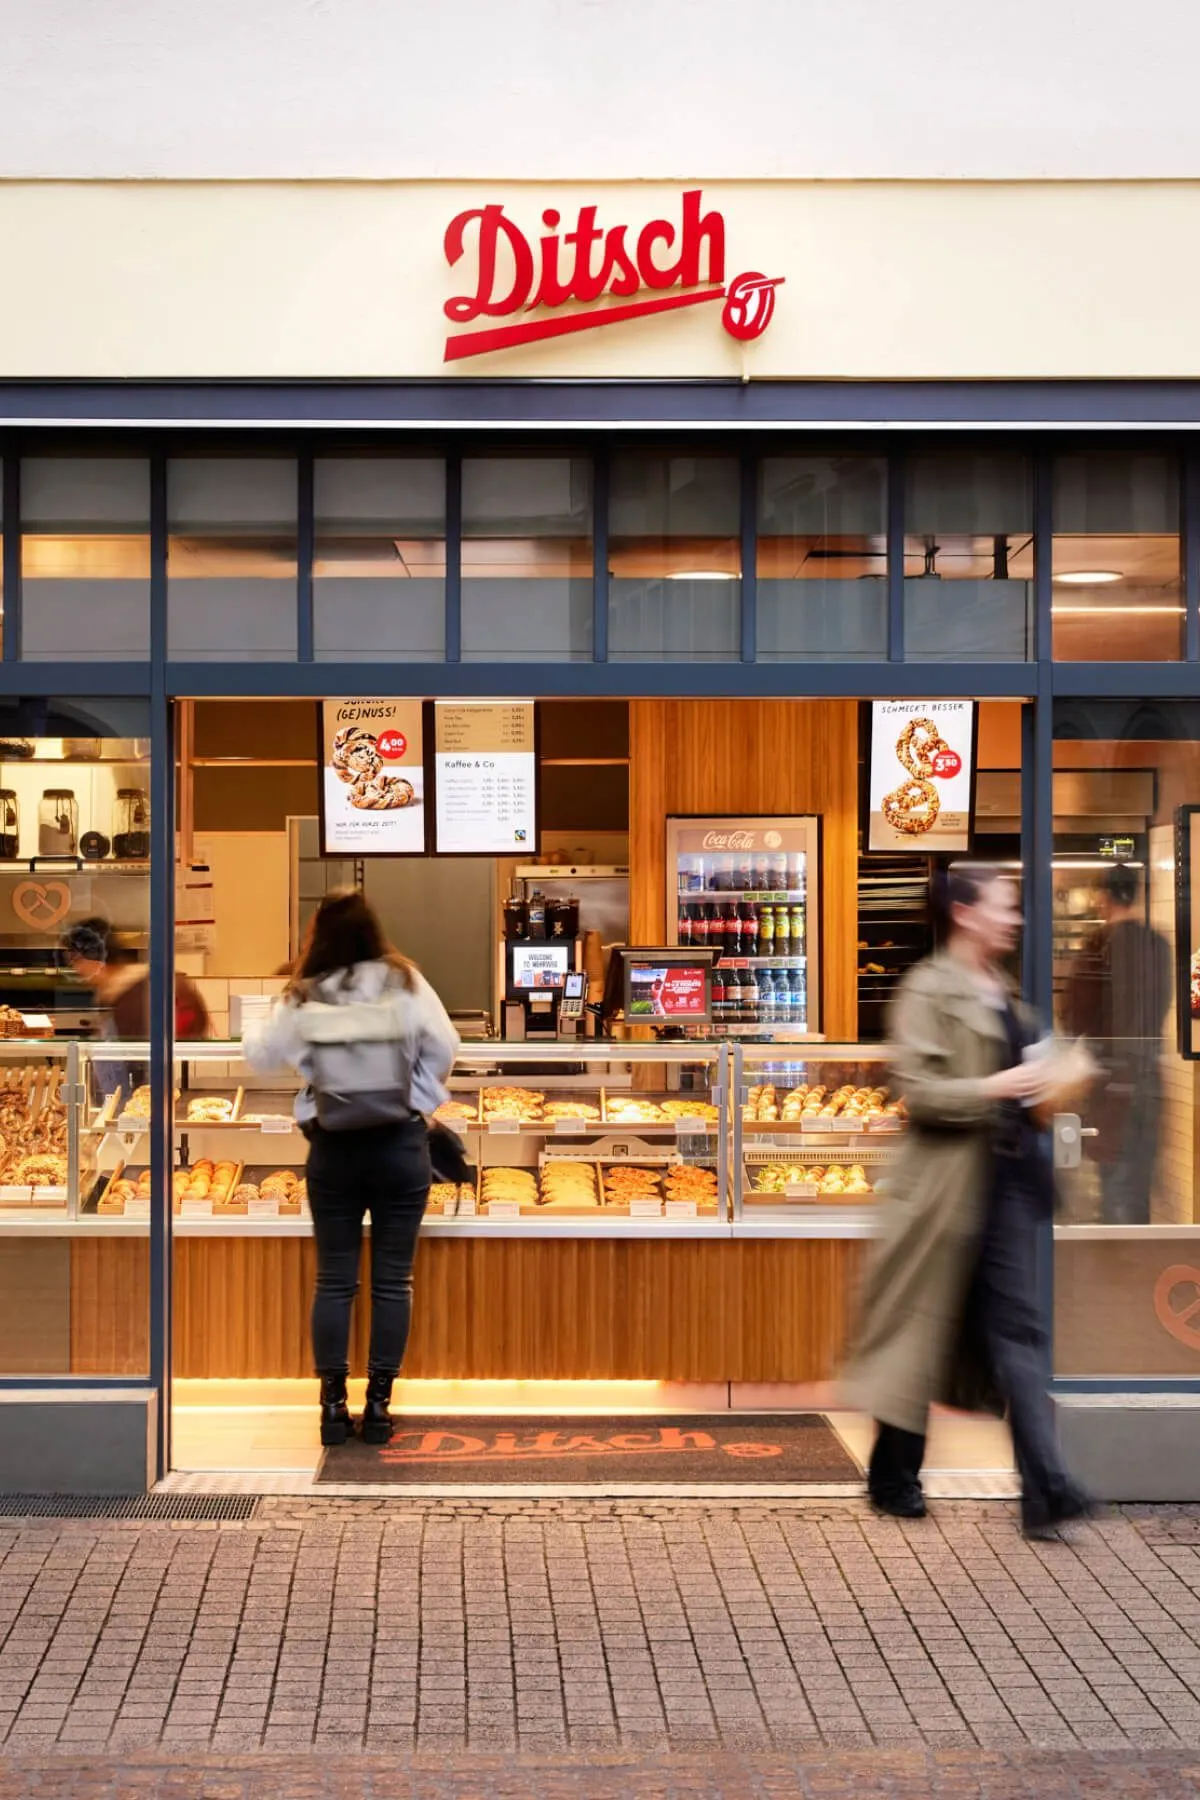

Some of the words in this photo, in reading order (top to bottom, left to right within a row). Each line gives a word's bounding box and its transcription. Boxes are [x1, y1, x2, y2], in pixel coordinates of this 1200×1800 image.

[443, 190, 725, 323] Ditsch
[336, 706, 397, 721] (GE)NUSS!
[881, 704, 928, 714] SCHMECKT
[932, 703, 965, 712] BESSER
[445, 760, 472, 769] Kaffee
[475, 761, 481, 769] &
[483, 760, 495, 769] Co
[379, 1428, 717, 1455] Ditsch
